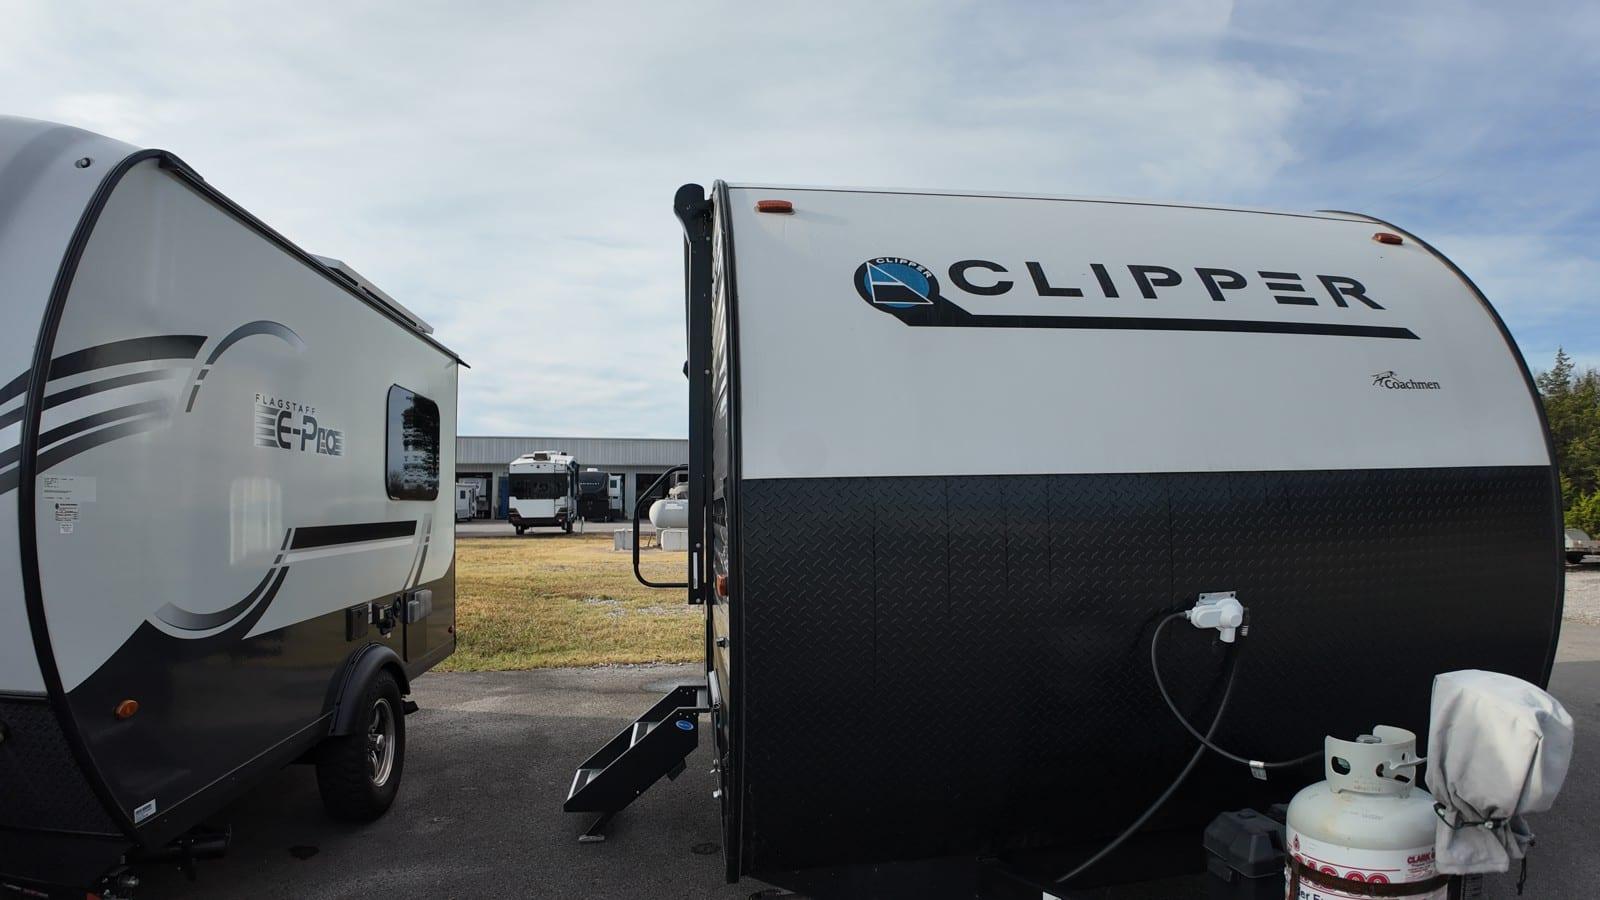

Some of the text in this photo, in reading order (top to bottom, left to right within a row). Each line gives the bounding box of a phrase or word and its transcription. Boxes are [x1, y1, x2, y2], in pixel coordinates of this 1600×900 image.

[876, 258, 932, 278] CLIPPER
[948, 259, 1386, 310] CLIPPER
[1385, 379, 1440, 389] Coachmen
[255, 393, 316, 414] FLAGSTAFF
